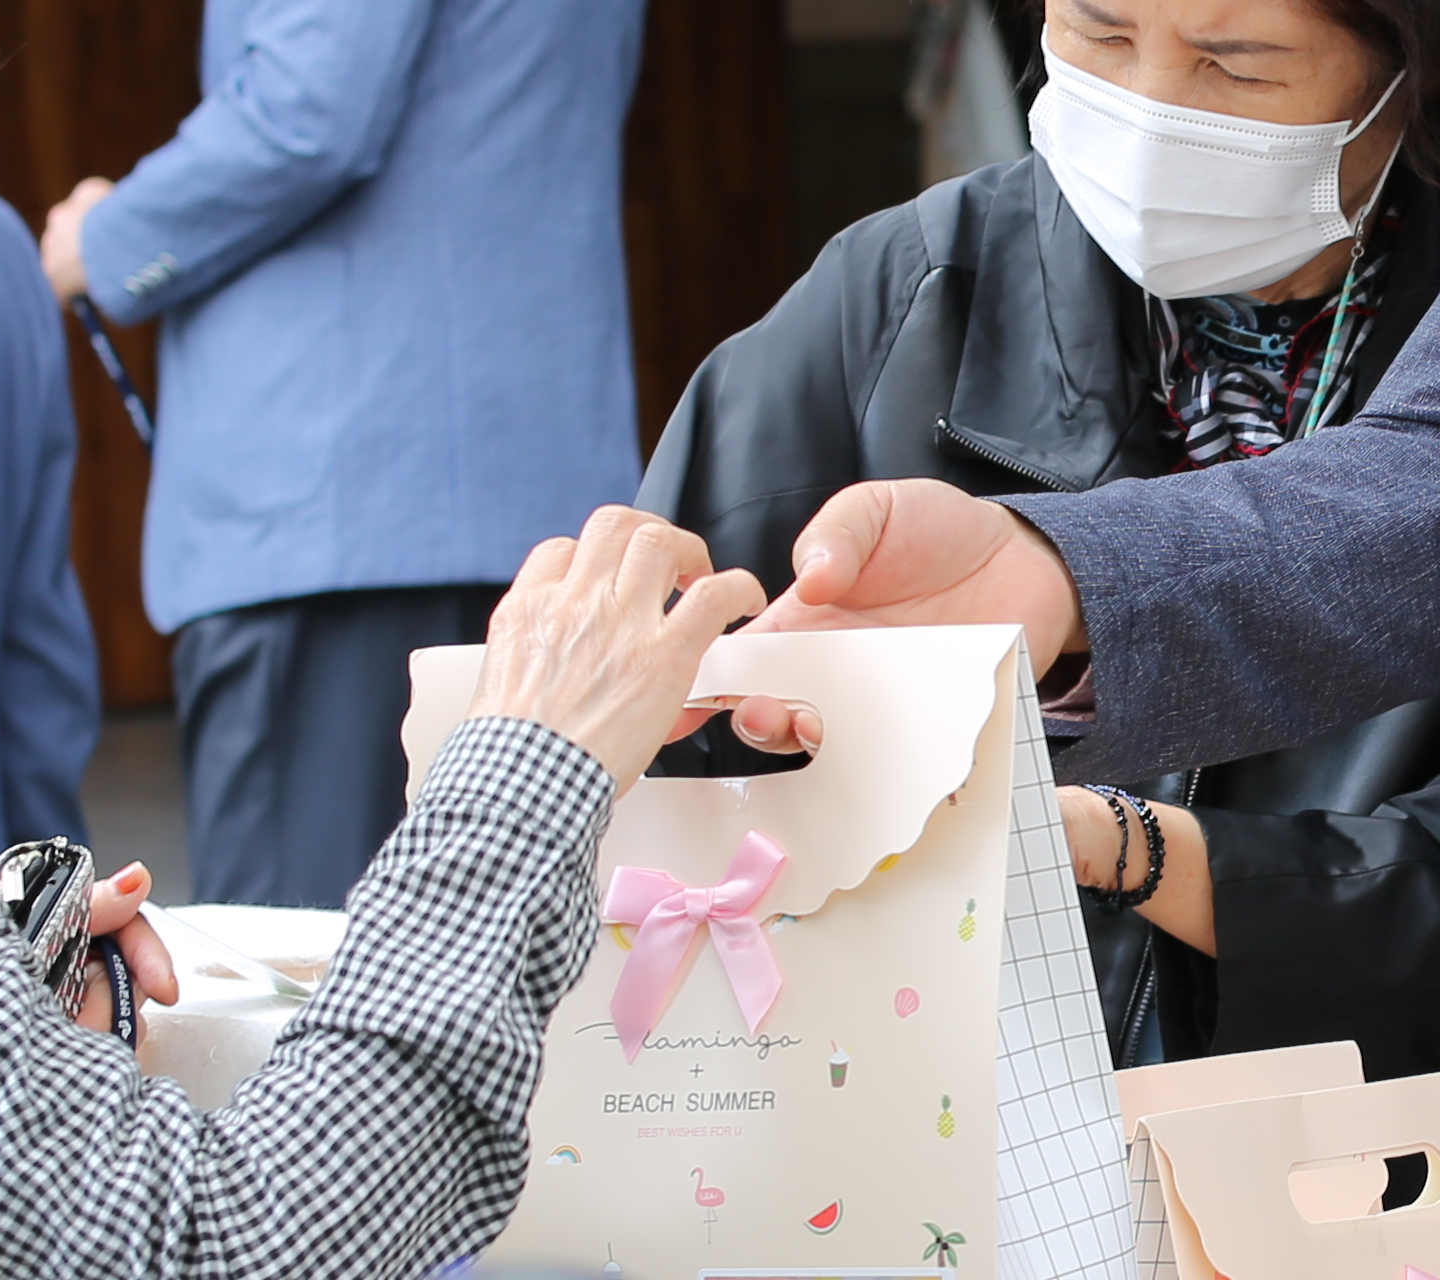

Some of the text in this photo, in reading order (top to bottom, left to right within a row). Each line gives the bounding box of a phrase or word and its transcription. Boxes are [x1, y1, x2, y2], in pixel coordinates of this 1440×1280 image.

[603, 1090, 776, 1113] BEACH SUMMER
[637, 1126, 742, 1138] BEST WISHES FOR U
